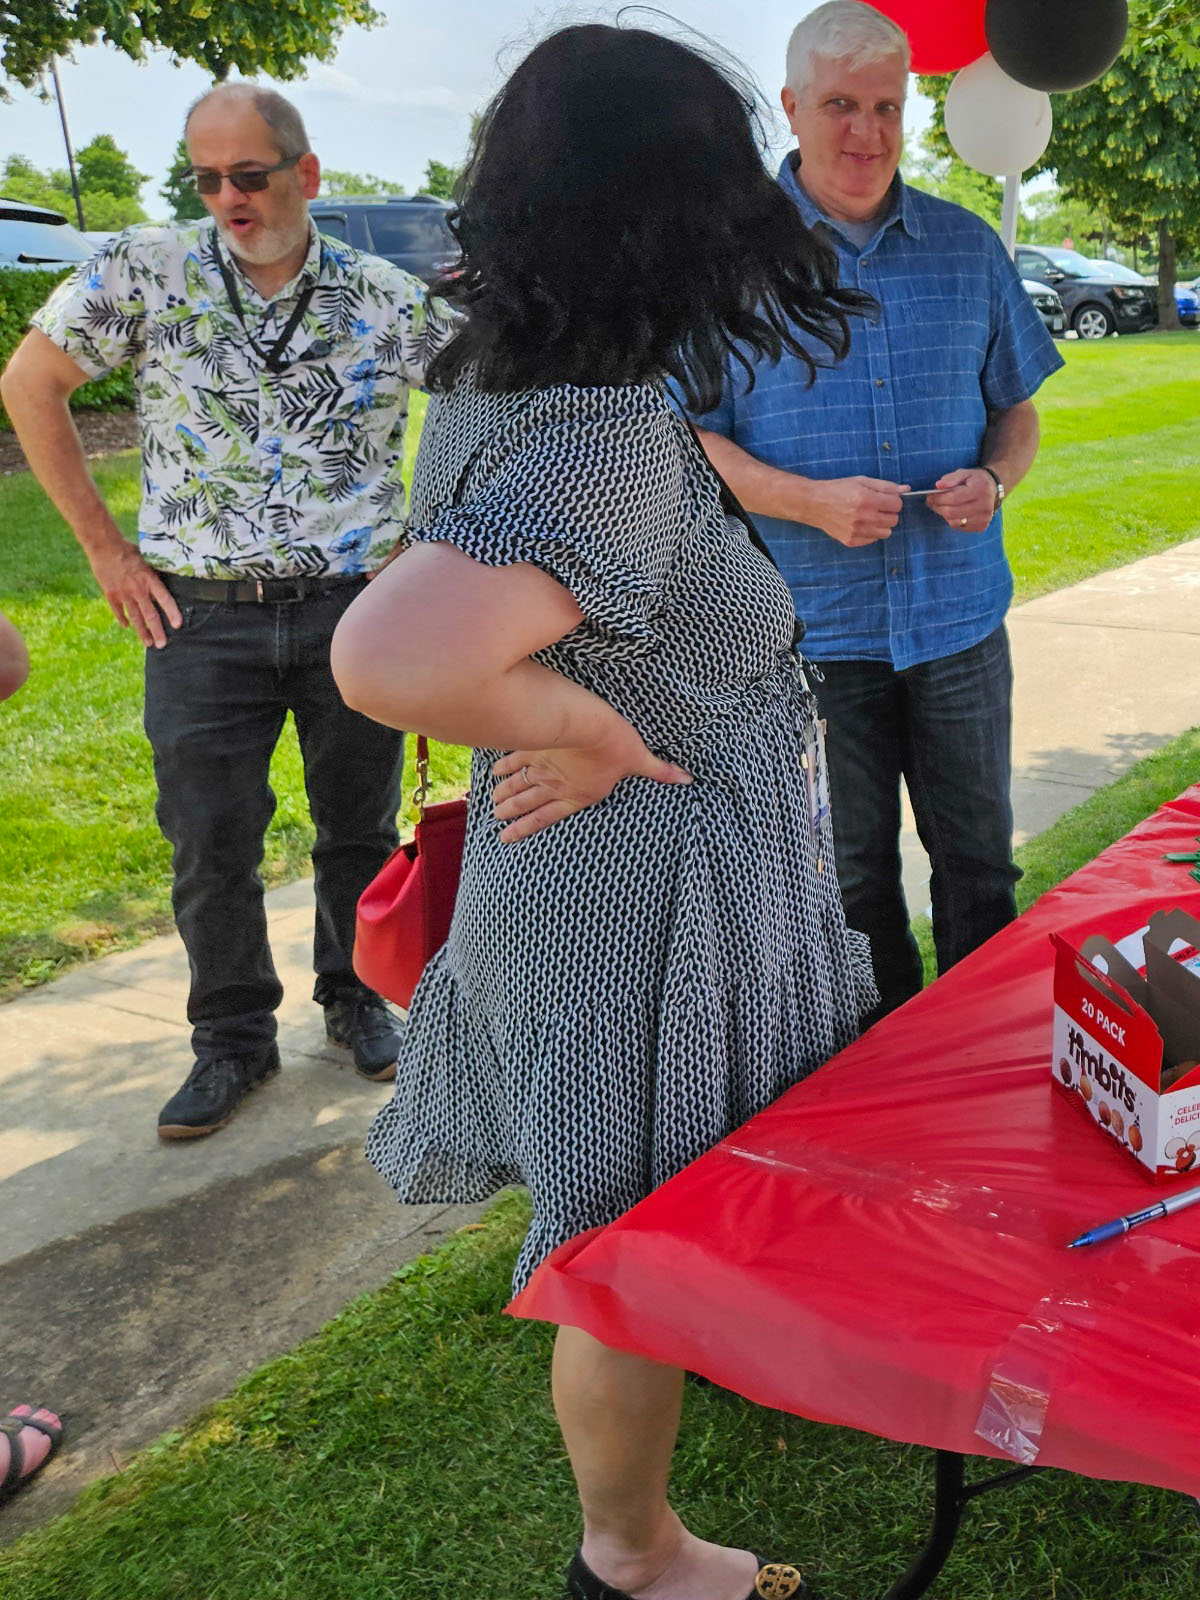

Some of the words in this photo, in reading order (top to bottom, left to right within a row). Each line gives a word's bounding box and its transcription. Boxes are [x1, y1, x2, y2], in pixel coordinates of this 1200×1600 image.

[1081, 997, 1095, 1019] 20
[1096, 1009, 1127, 1047] PACK
[1067, 1027, 1137, 1113] timbits
